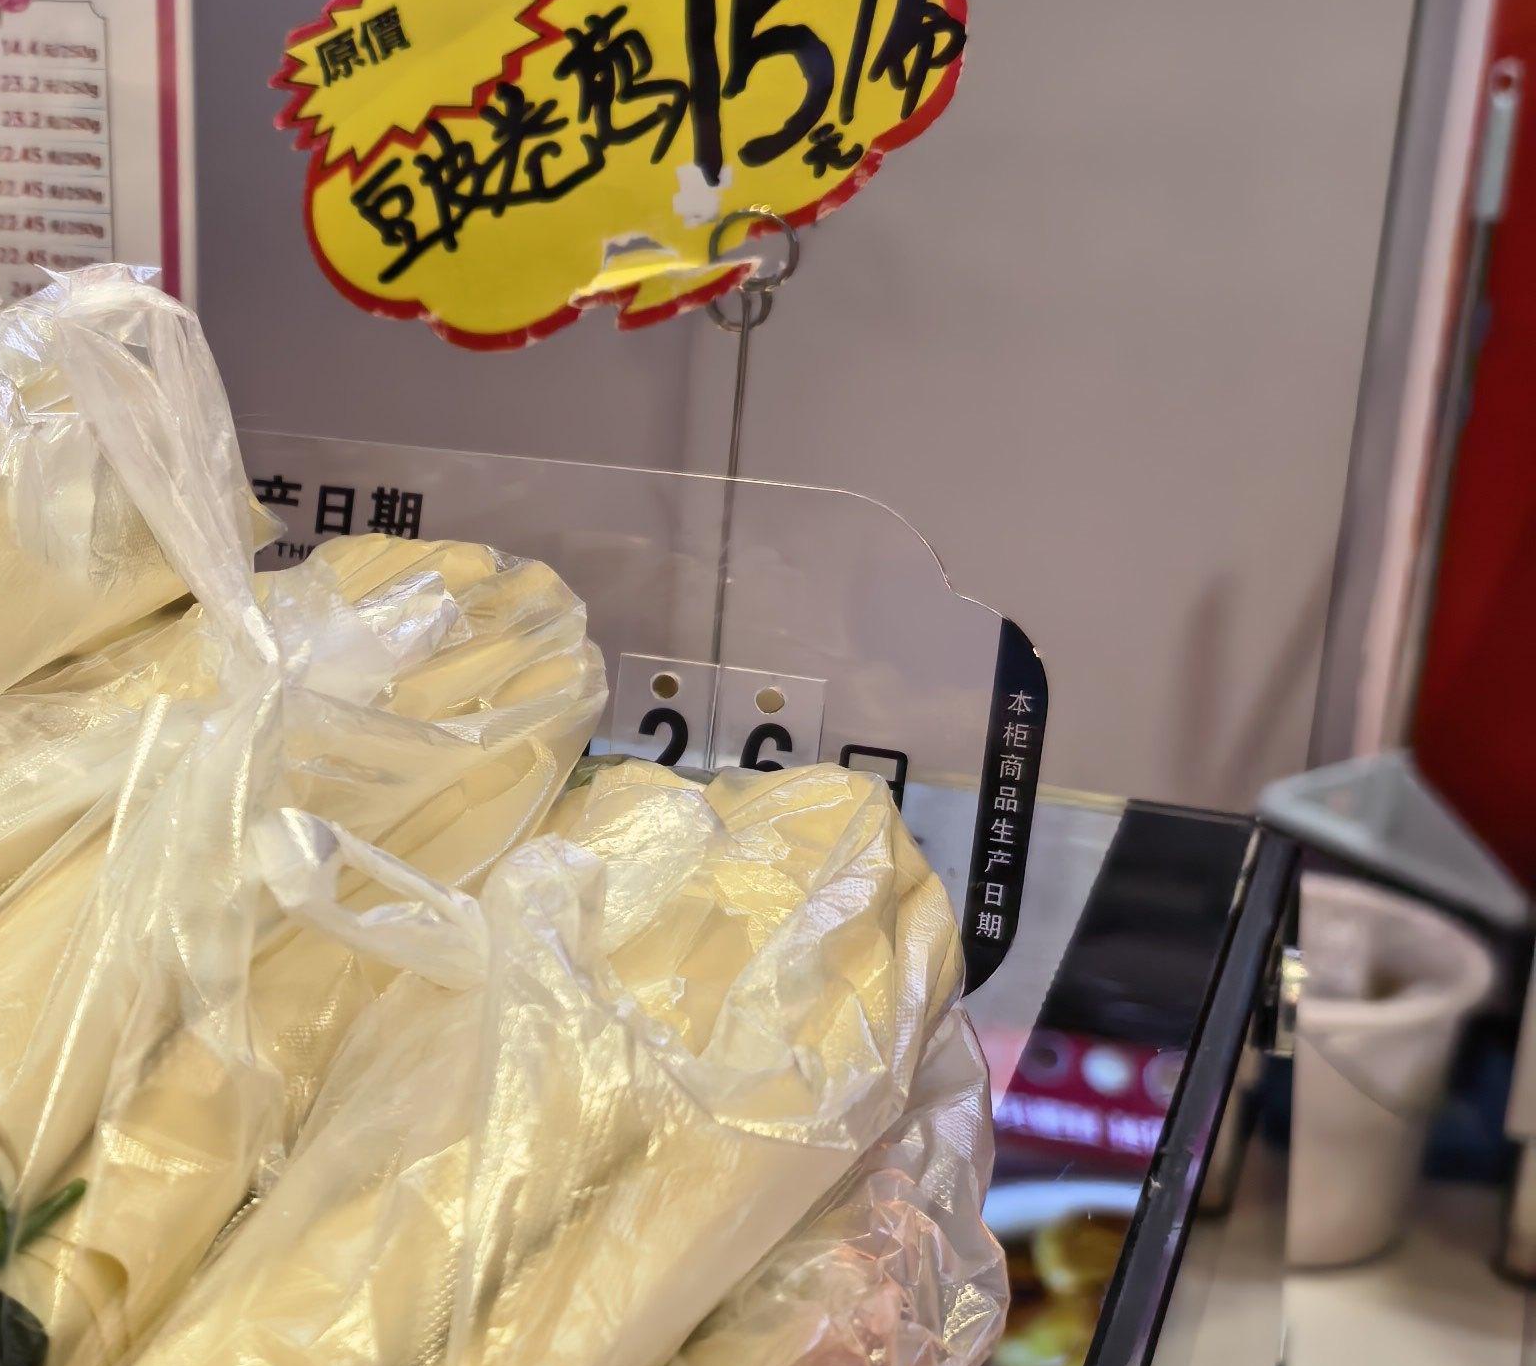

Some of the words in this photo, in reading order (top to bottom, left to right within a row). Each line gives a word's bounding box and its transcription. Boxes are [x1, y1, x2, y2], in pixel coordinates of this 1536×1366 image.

[315, 7, 411, 86] 原價
[975, 690, 1034, 940] 本柜商品生产日期
